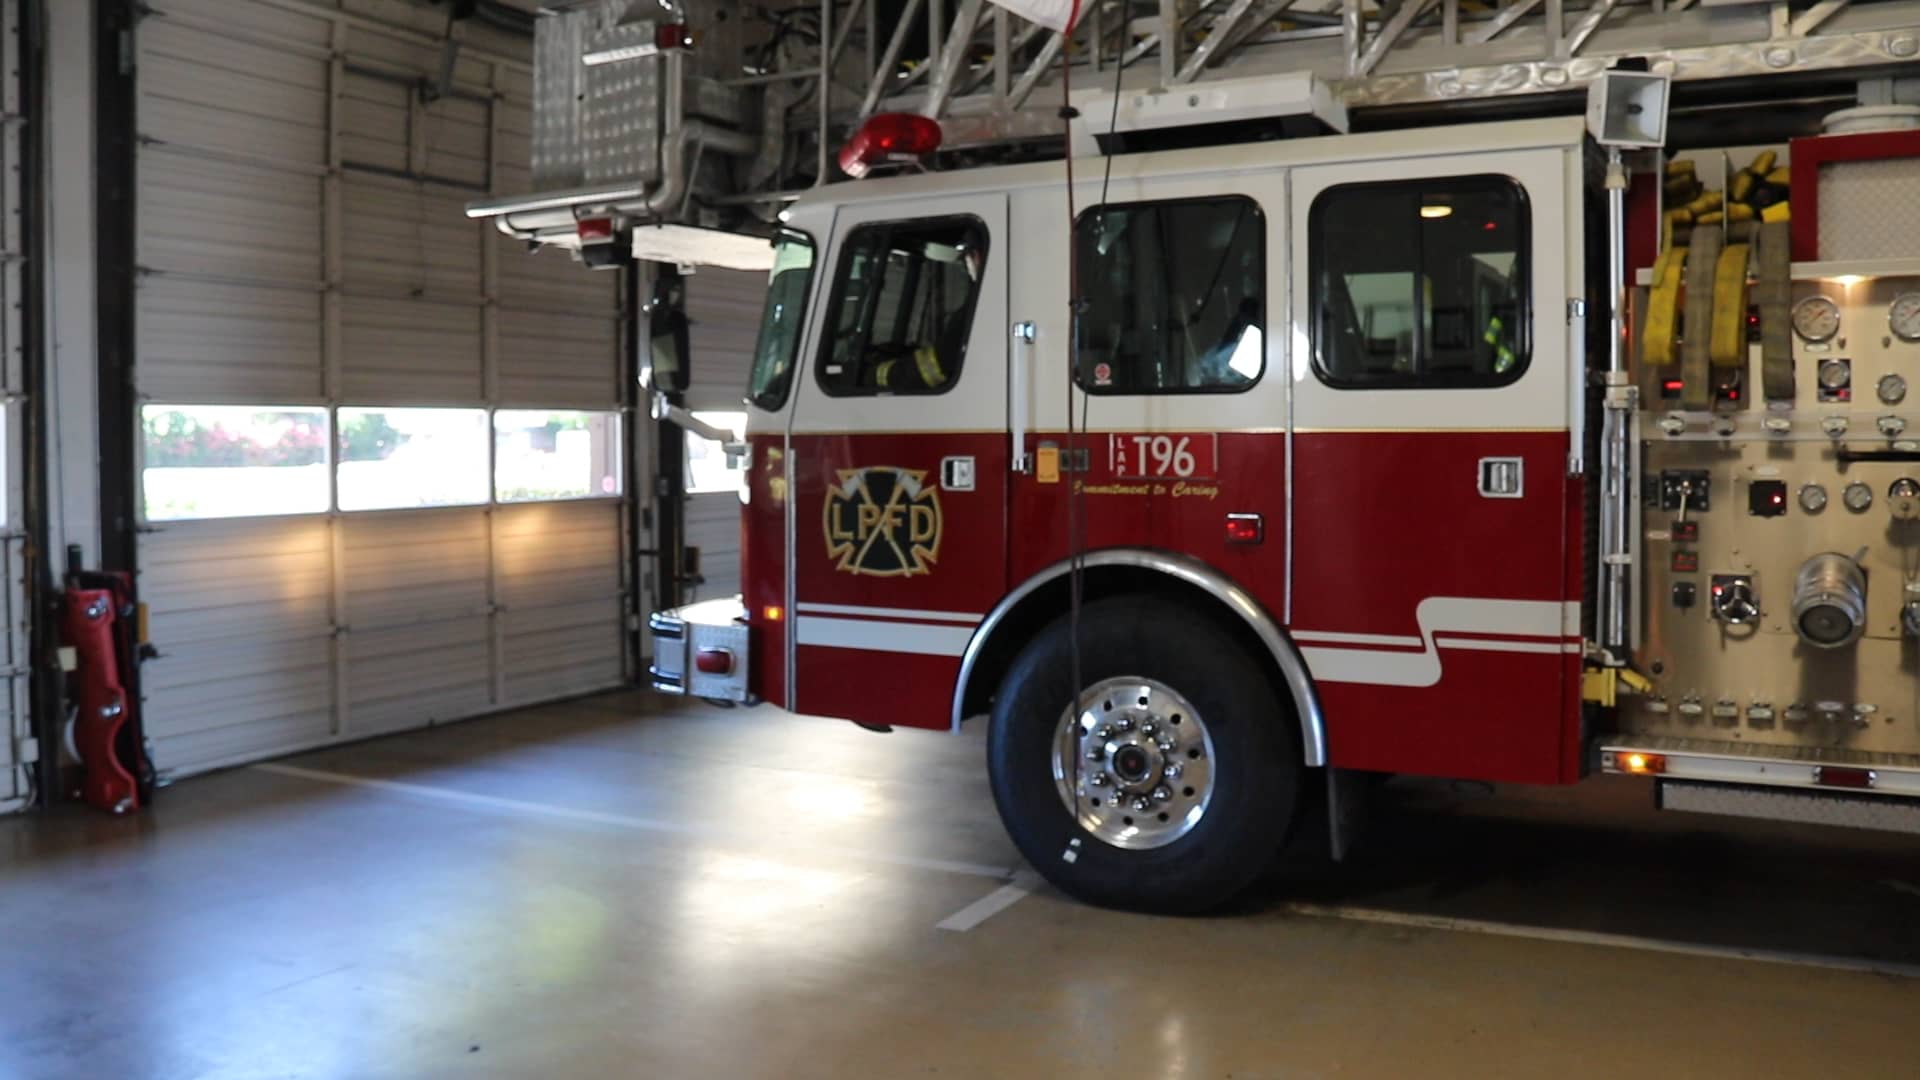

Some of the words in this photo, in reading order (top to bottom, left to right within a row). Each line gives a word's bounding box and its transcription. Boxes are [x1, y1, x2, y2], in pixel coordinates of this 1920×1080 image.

[1116, 437, 1126, 477] LAP
[1132, 436, 1195, 477] T96
[1153, 485, 1167, 495] to
[1172, 481, 1219, 500] Caring
[832, 503, 936, 542] LPFD
